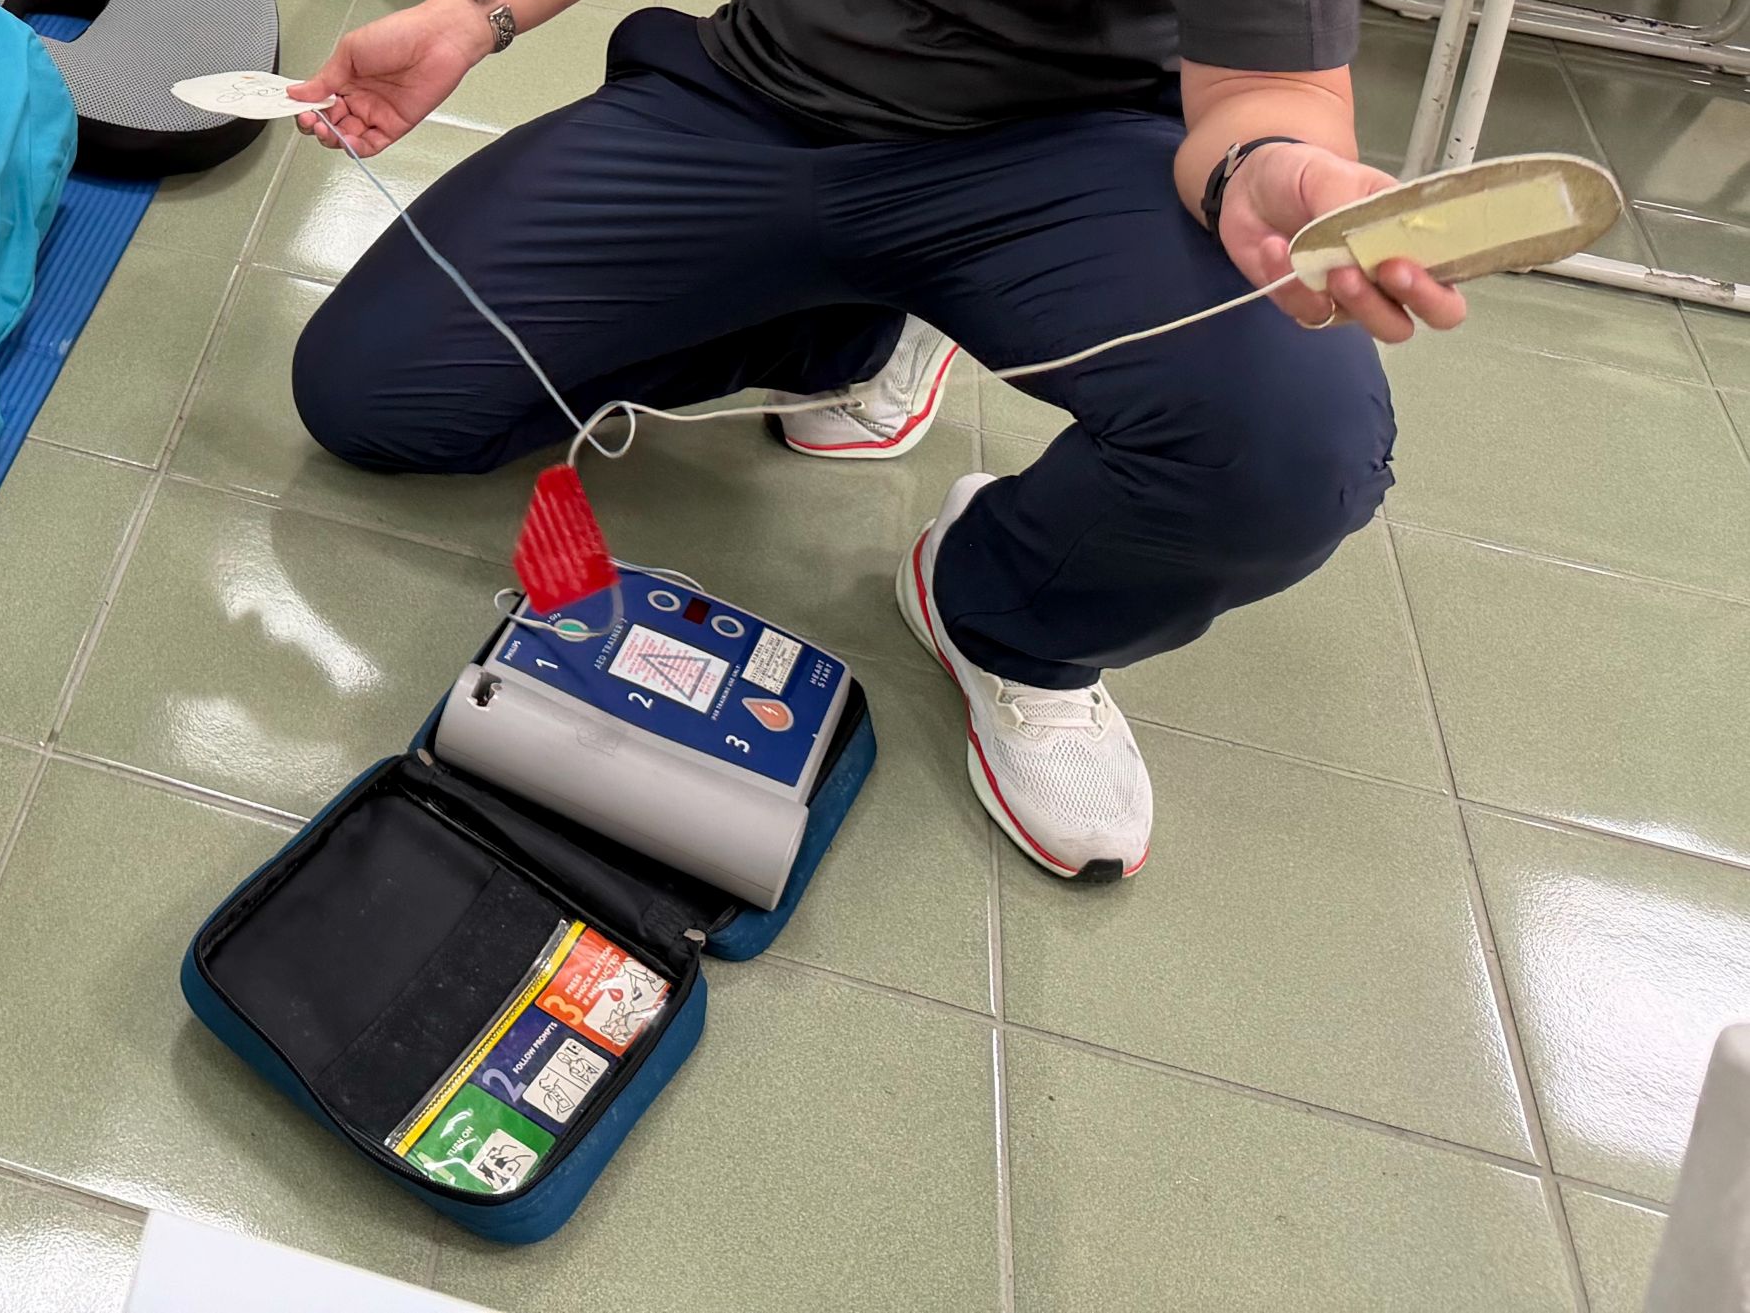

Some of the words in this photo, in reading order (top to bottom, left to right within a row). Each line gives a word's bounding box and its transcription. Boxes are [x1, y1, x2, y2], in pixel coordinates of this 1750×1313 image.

[602, 624, 625, 655] TRAINER
[535, 658, 558, 669] 1
[809, 659, 825, 685] HEART
[818, 663, 833, 688] START
[628, 692, 653, 708] 2
[725, 734, 750, 754] 3
[565, 973, 583, 995] PRESS
[573, 974, 594, 1001] SHOCK
[590, 945, 613, 978] BUTTON
[543, 995, 584, 1025] 3
[582, 996, 590, 1006] IF
[512, 1045, 537, 1074] FOLLOW
[534, 1021, 558, 1050] PROMPTS
[482, 1068, 527, 1103] 2
[445, 1135, 465, 1159] TURN
[461, 1125, 475, 1140] ON
